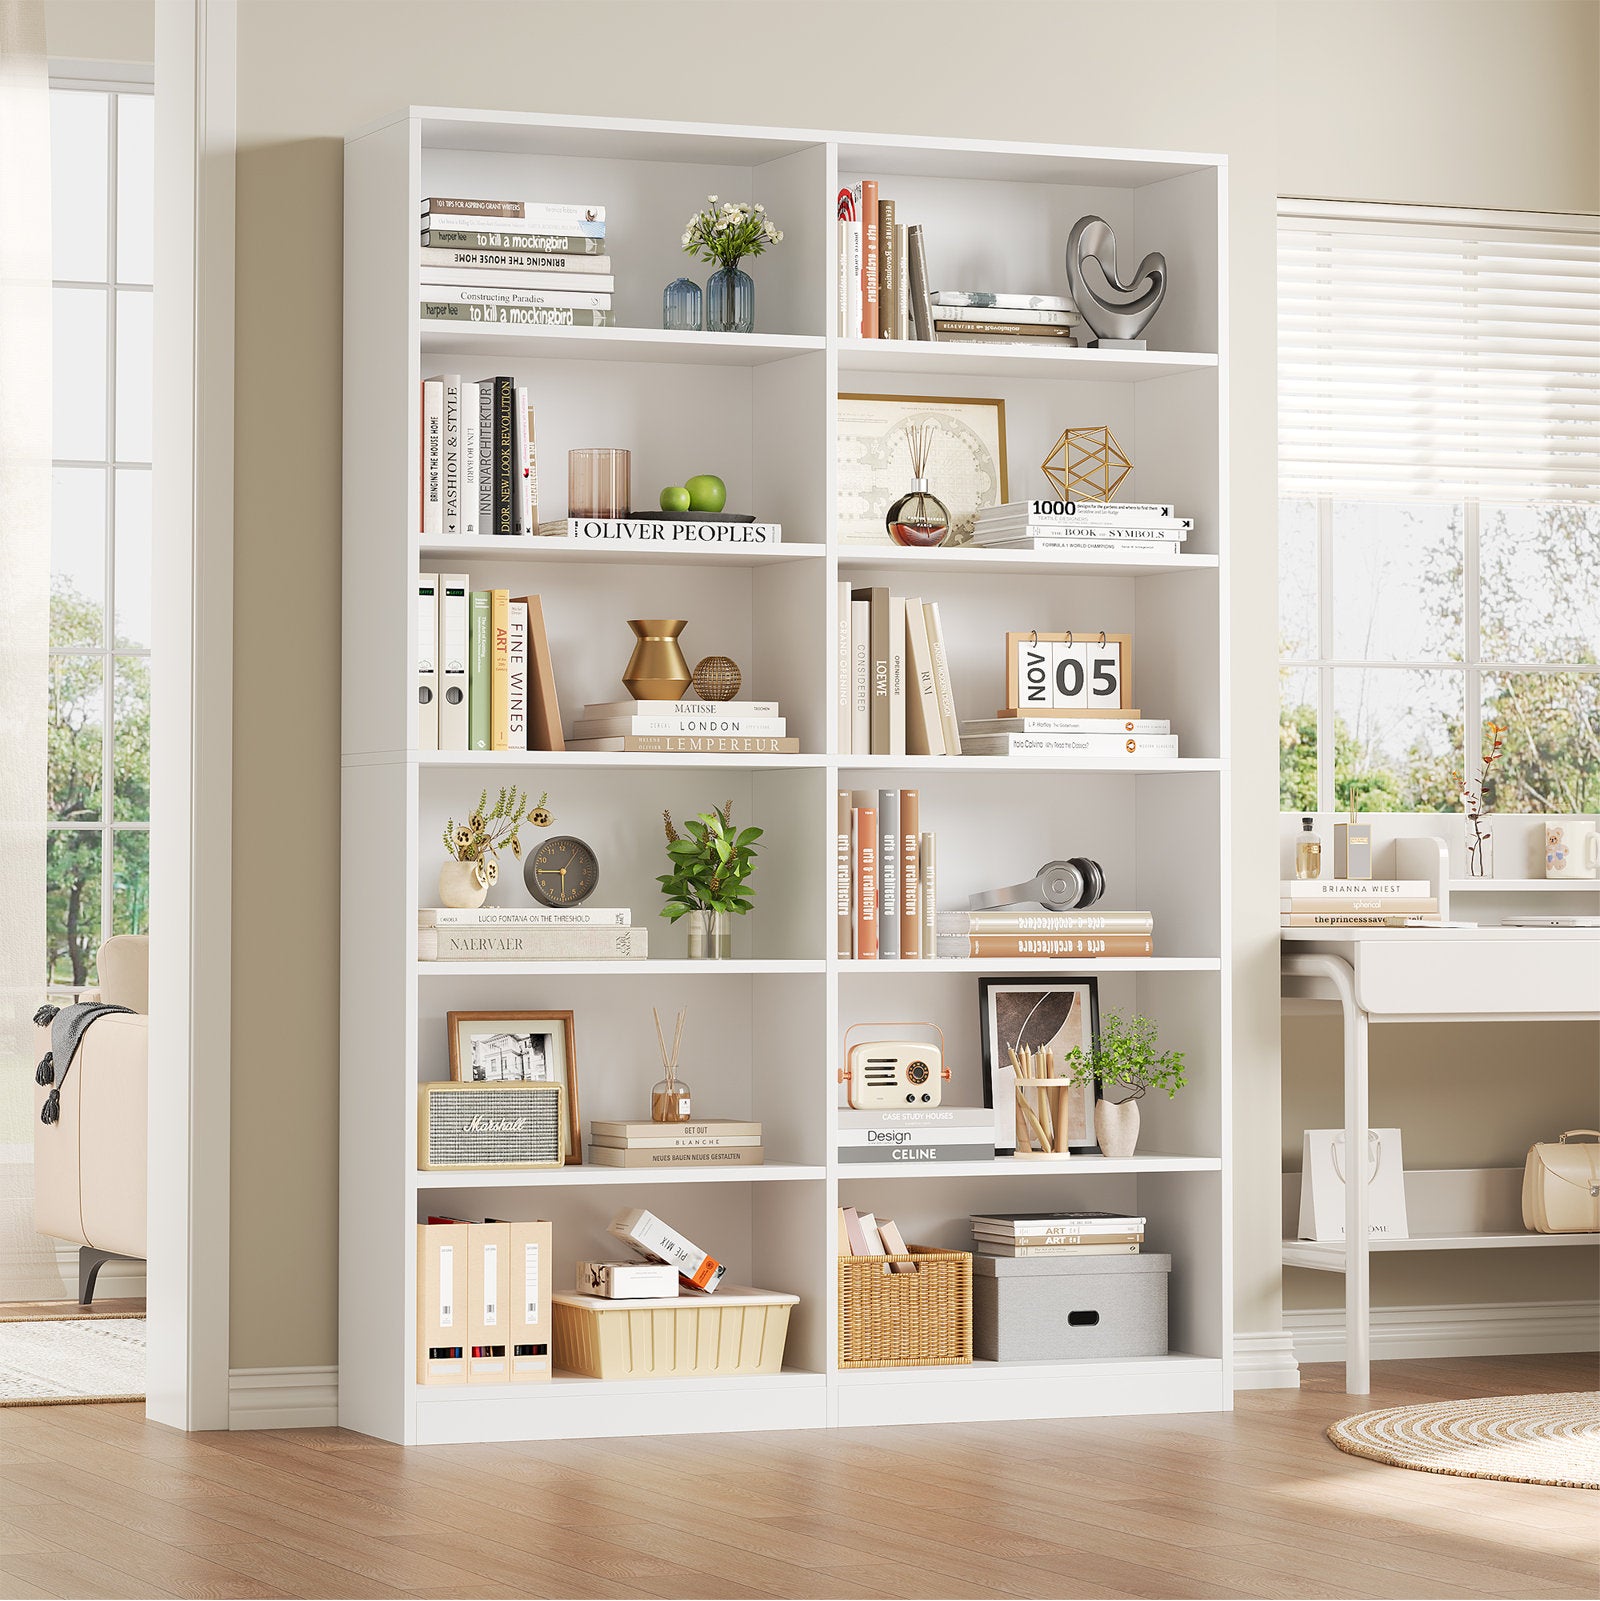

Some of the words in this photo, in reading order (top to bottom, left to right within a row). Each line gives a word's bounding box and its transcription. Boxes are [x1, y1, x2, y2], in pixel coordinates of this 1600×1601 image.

[438, 232, 456, 241] harper
[456, 233, 467, 241] lee
[477, 234, 487, 246] to
[490, 233, 501, 247] kill
[503, 236, 510, 247] a
[512, 234, 568, 252] mockingbird
[454, 254, 477, 263] HOME
[480, 255, 506, 265] HOUSE
[509, 257, 524, 266] THE
[526, 258, 566, 267] BRINGING
[460, 292, 510, 304] Constructing
[426, 304, 447, 315] harper
[448, 305, 458, 315] lee
[469, 305, 480, 320] to
[483, 305, 497, 321] kill
[500, 309, 507, 322] a
[509, 308, 574, 325] mockingbird
[447, 387, 457, 433] STYLE
[501, 381, 510, 446] REVOLUTION
[430, 416, 439, 435] HOME
[430, 436, 439, 457] HOUSE
[447, 438, 457, 448] &
[480, 388, 492, 515] INNENARCHITEKTUR
[430, 458, 439, 470] THE
[501, 449, 510, 478] LOOK
[430, 471, 439, 502] BRINGING
[447, 452, 457, 517] FASHION
[501, 480, 510, 505] NEW
[1033, 500, 1076, 515] 1000
[584, 522, 665, 541] OLIVER
[673, 524, 766, 543] PEOPLES
[1064, 528, 1097, 537] BOOK
[1109, 530, 1165, 539] SYMBOLS
[496, 628, 507, 654] ART
[511, 623, 523, 663] FINE
[857, 644, 865, 712] CONSIDERED
[877, 660, 887, 697] LOEWE
[921, 671, 933, 695] RUM
[1027, 652, 1046, 701] NOV
[1056, 658, 1117, 696] 05
[510, 672, 523, 732] WINES
[675, 704, 717, 713] MATISSE
[680, 721, 740, 731] LONDON
[666, 737, 780, 752] LEMPEREUR
[839, 834, 849, 851] arts
[884, 834, 895, 851] arts
[906, 834, 916, 851] arts
[863, 848, 874, 863] arts
[839, 865, 849, 916] architecture
[863, 875, 874, 920] architecture
[884, 865, 895, 916] architecture
[906, 865, 916, 916] architecture
[1322, 885, 1367, 893] BRIANNA
[554, 915, 590, 923] THRESHOLD
[1315, 915, 1329, 923] the
[1330, 916, 1367, 924] princess
[450, 938, 523, 951] NAERVAER
[1018, 940, 1073, 952] architecture
[463, 1114, 526, 1132] Marshall
[882, 1111, 901, 1121] CASE
[903, 1111, 924, 1121] STUDY
[925, 1110, 953, 1120] HOUSES
[697, 1126, 707, 1134] OUT
[867, 1129, 911, 1145] Design
[892, 1147, 937, 1160] CELINE
[659, 1236, 675, 1252] MIX
[1045, 1236, 1066, 1244] ART
[675, 1246, 688, 1262] PIE
